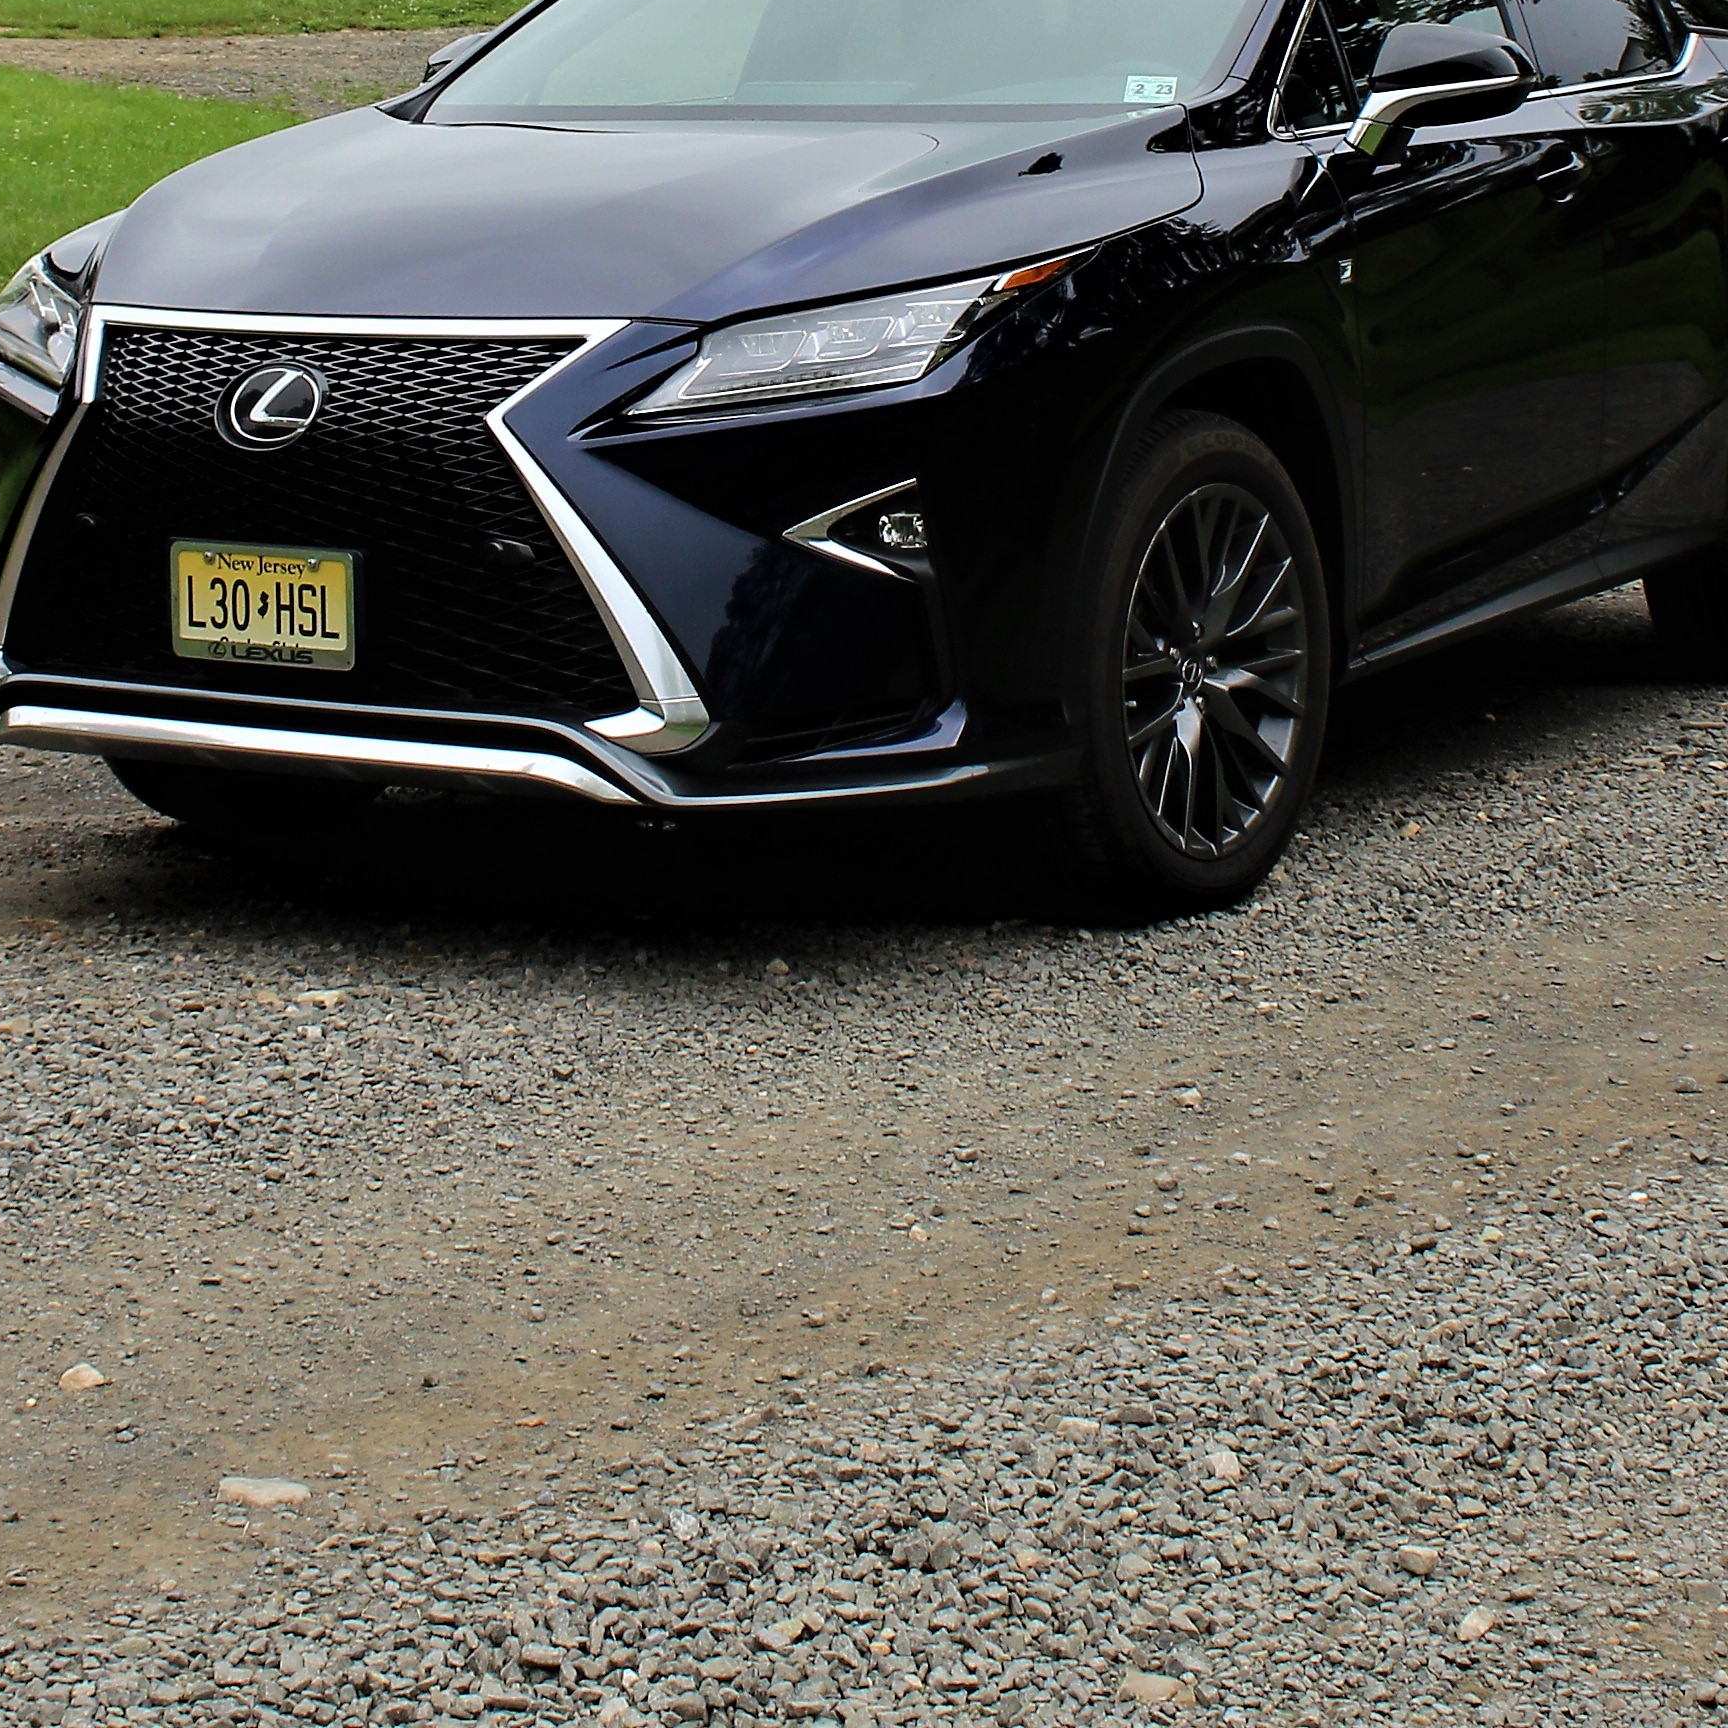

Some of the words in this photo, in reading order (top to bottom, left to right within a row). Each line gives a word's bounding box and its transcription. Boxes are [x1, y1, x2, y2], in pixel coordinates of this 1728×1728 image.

[1155, 84, 1174, 95] 23
[217, 553, 254, 571] New
[257, 555, 305, 579] Jersey
[187, 575, 250, 631] L30
[275, 582, 340, 639] HSL
[231, 645, 313, 664] LEXUS
